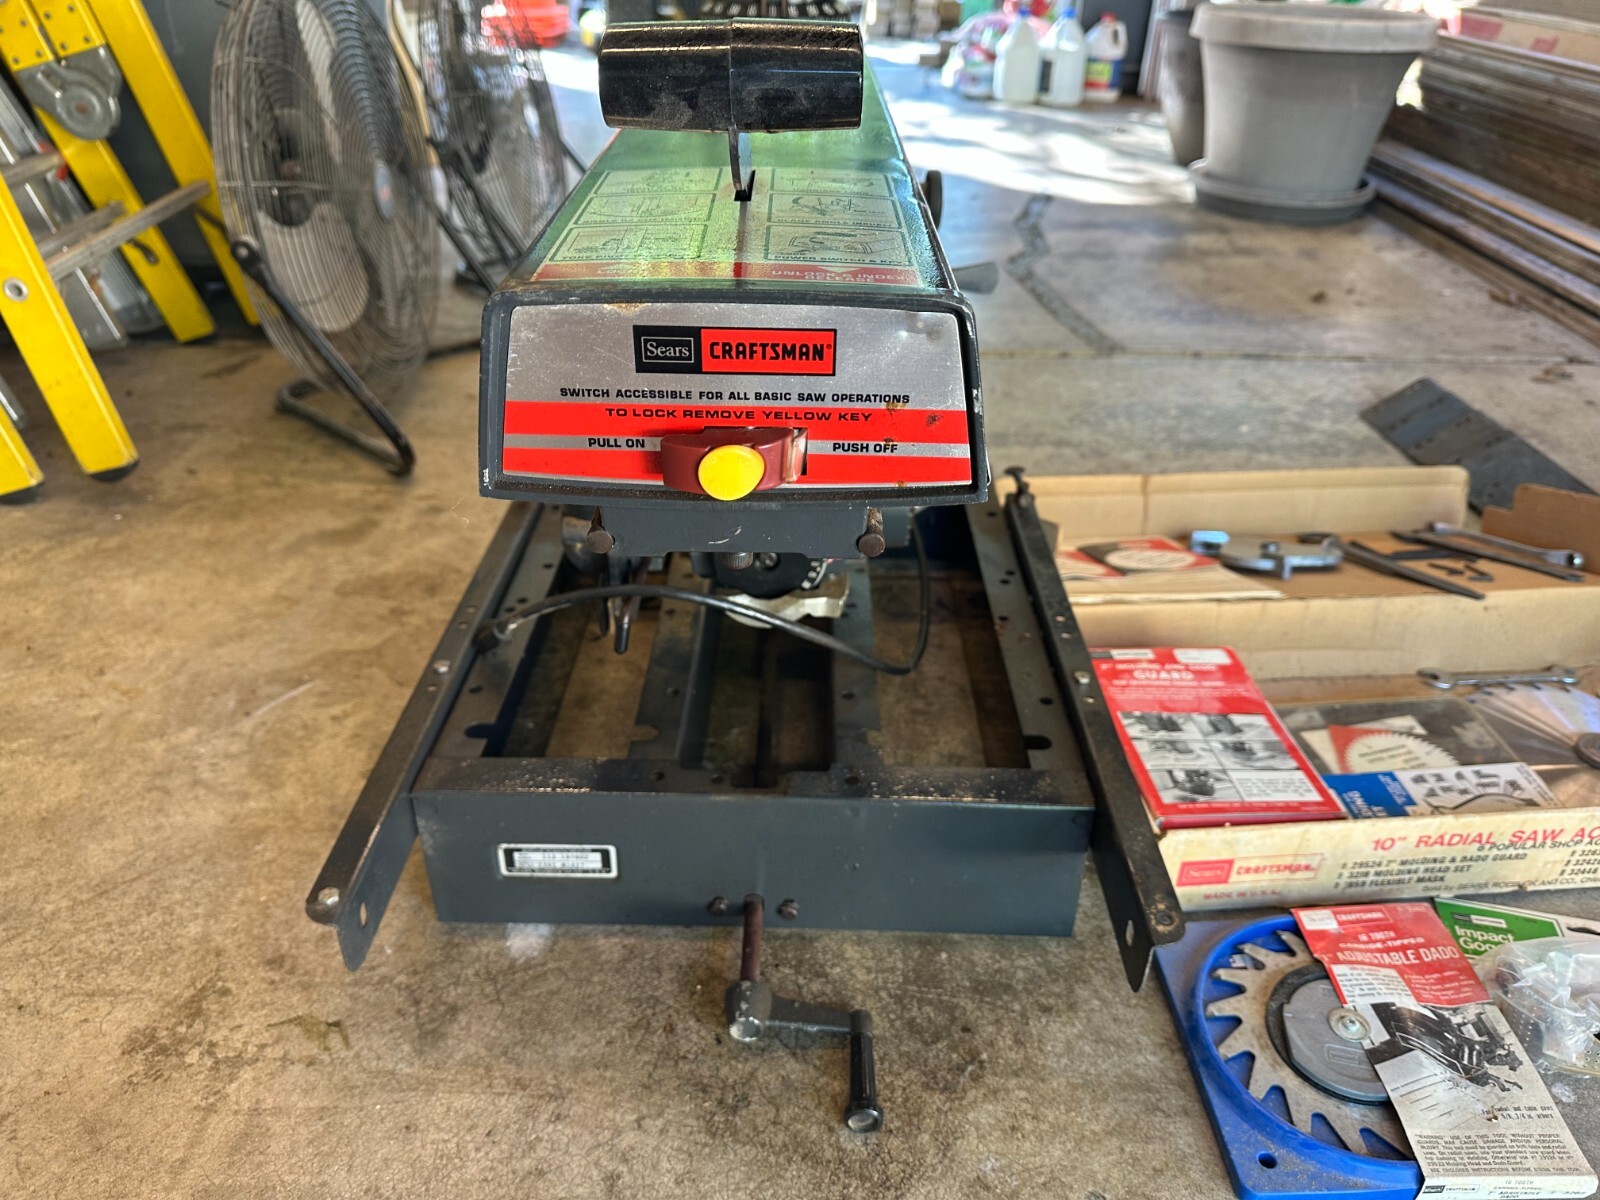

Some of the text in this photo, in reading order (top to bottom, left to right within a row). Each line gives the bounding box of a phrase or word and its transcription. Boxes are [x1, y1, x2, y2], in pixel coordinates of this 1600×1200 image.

[804, 274, 875, 283] RELEASE
[646, 341, 825, 362] Sears CRAFTSMAN
[560, 387, 911, 404] SWITCH ACCESSIBLE FOR ALL BASIC SAW OPERATIONS
[605, 408, 873, 422] TO LOCK REMOVE YELLOW KEY
[588, 438, 646, 449] PULL ON
[832, 442, 898, 454] PUSH OFF
[1132, 669, 1195, 681] GUARD
[1371, 835, 1408, 852] 10"
[1415, 830, 1498, 849] RADIAL
[1509, 828, 1565, 844] SAW
[1488, 840, 1546, 851] POPULAR
[1549, 839, 1583, 849] SHOP
[1398, 856, 1447, 867] MOLDING
[1459, 854, 1489, 863] DADO
[1491, 852, 1528, 862] GUARD
[1235, 863, 1314, 876] CRAFTSMAN
[1372, 867, 1421, 877] MOLDING
[1422, 865, 1452, 874] HEAD
[1452, 864, 1474, 873] SET
[1368, 874, 1446, 887] FLEXIBLE MASK
[1203, 891, 1233, 900] MADE
[1454, 924, 1515, 943] Impact
[1335, 947, 1421, 966] ADJUSTABLE
[1420, 945, 1461, 962] DADO
